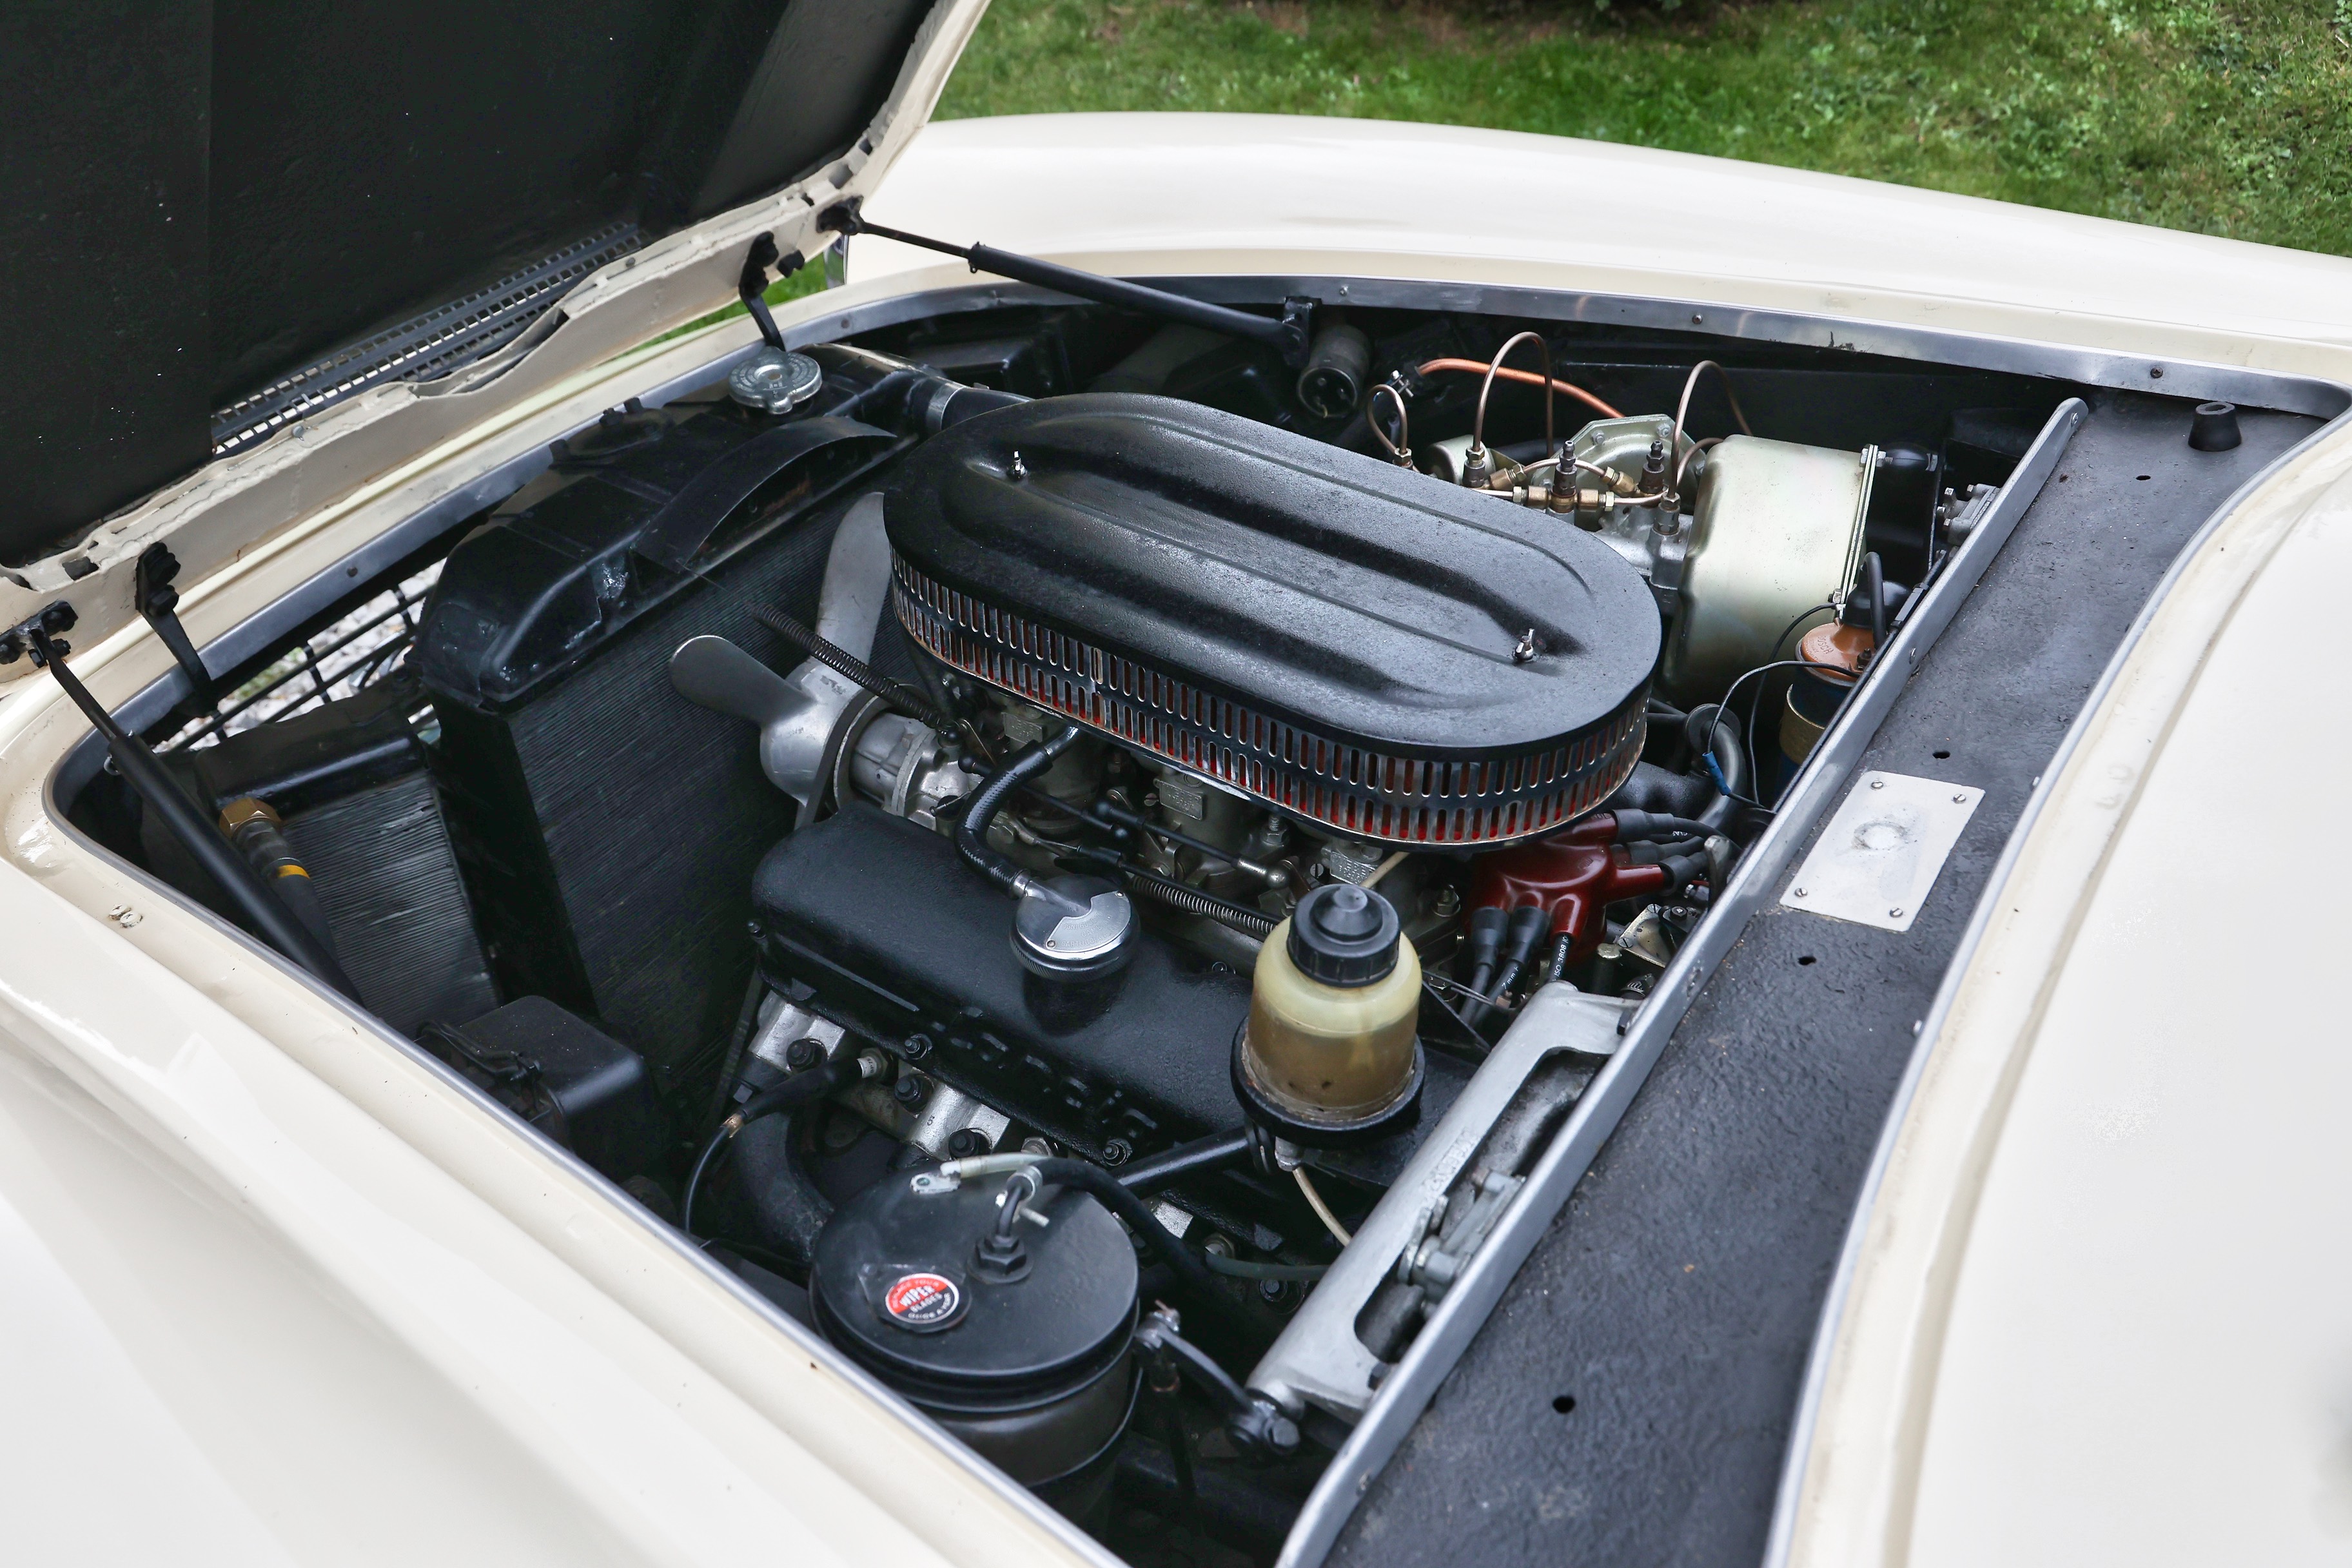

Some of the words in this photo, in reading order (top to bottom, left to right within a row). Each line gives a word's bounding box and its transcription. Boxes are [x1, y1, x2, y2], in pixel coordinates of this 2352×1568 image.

[1558, 945, 1567, 963] 3808
[1507, 972, 1516, 985] mm
[899, 1285, 935, 1307] WIPER
